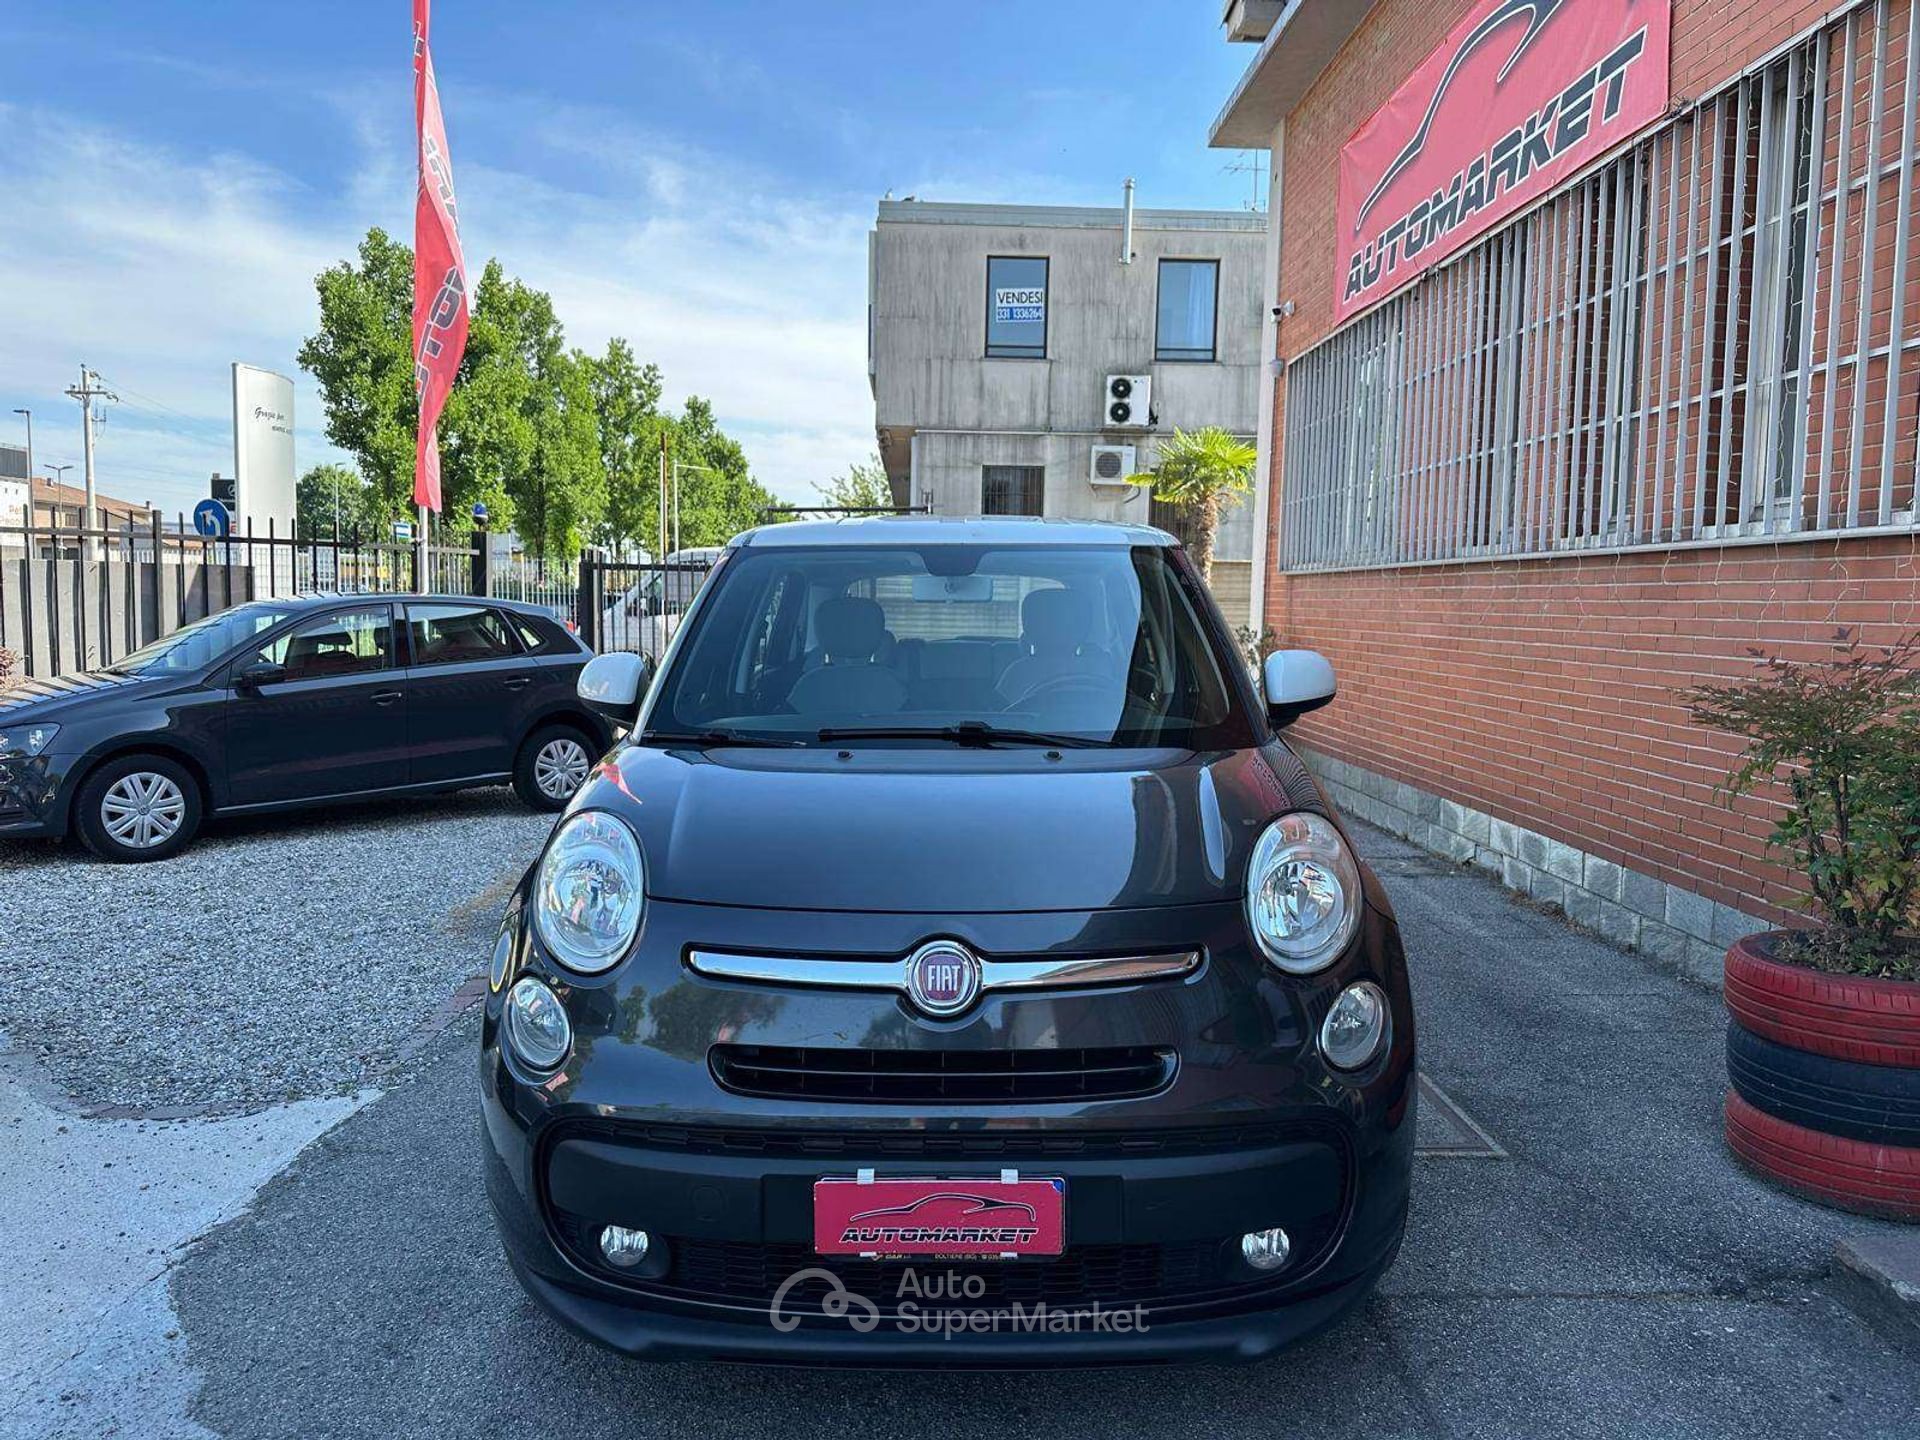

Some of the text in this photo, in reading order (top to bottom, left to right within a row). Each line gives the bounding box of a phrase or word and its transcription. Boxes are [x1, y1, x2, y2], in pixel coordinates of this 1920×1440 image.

[1342, 23, 1648, 304] AUTOMARKET
[997, 291, 1043, 304] VENDESI
[927, 965, 961, 991] FIAT
[839, 1227, 1039, 1245] AUTOMARKET
